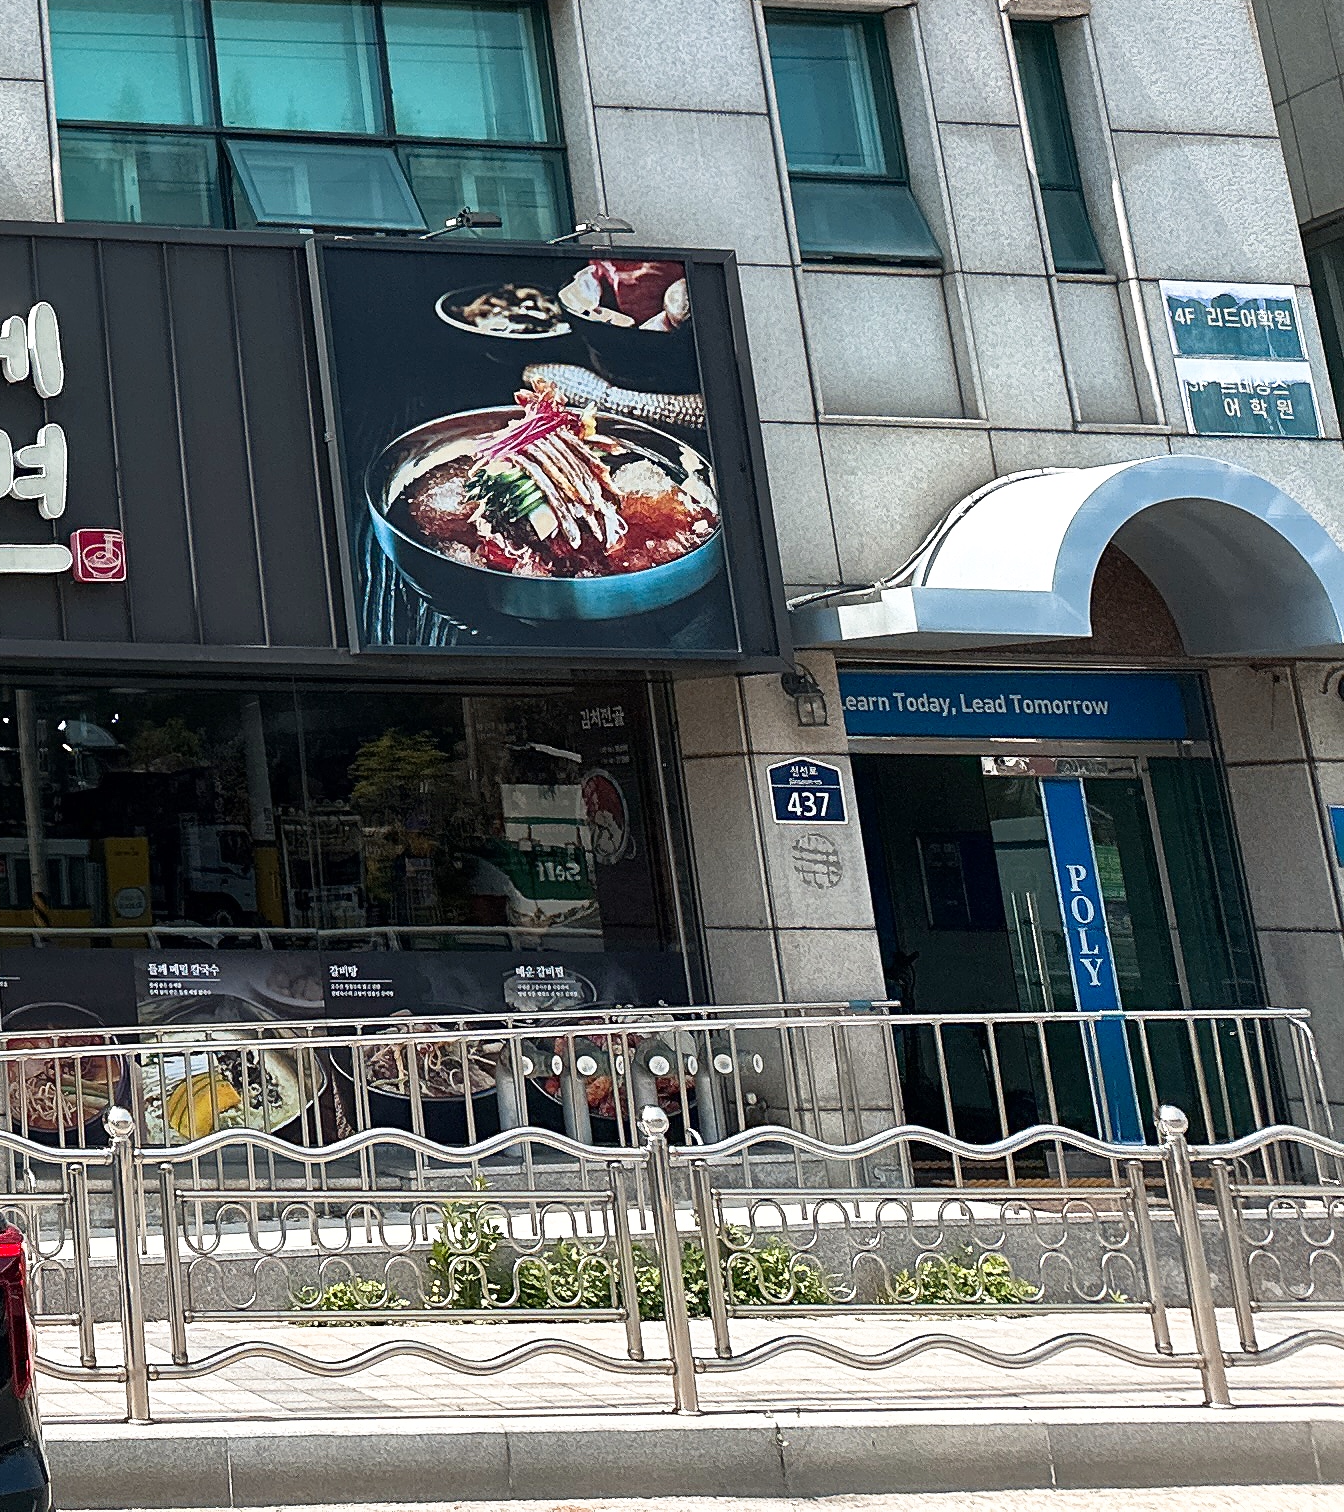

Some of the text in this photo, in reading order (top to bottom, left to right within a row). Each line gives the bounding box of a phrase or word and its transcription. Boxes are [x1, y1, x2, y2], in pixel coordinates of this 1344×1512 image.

[1174, 307, 1292, 330] 4F 리드어학원
[892, 692, 957, 717] Today,
[959, 693, 1007, 713] Lead
[1009, 694, 1108, 715] Tomorrow
[787, 791, 830, 817] 437
[1065, 864, 1104, 986] POLY
